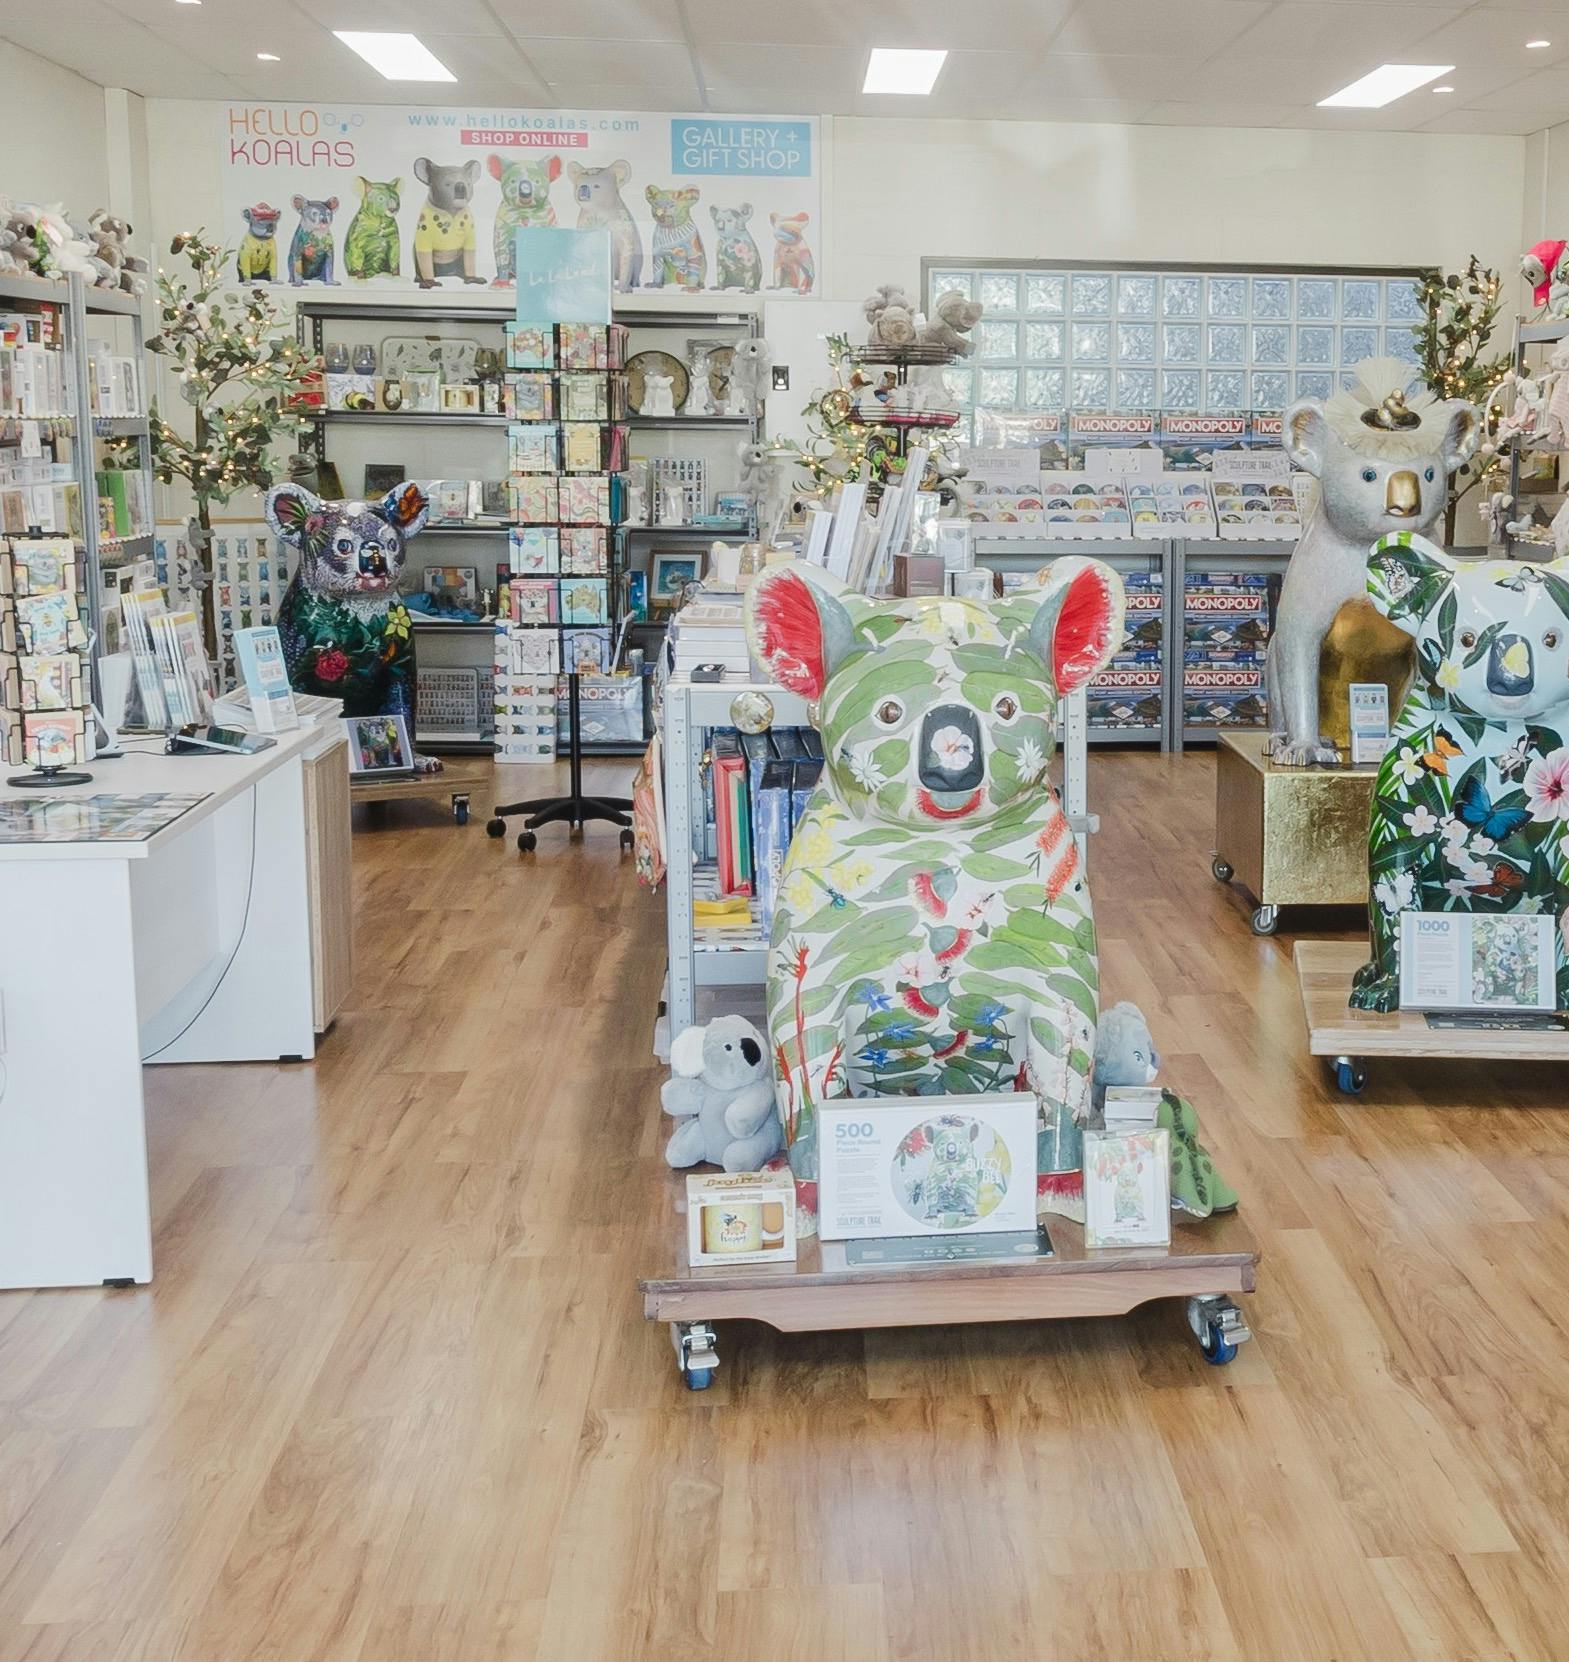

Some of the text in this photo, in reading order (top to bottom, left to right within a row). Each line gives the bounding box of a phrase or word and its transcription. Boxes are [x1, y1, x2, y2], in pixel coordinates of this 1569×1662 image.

[229, 108, 319, 137] HELLO
[408, 112, 640, 132] www.hellokoalas.com
[471, 131, 579, 146] SHOP ONLINE
[682, 126, 780, 148] GALLERY
[230, 138, 356, 168] KOALAS
[682, 148, 801, 170] GIFT SHOP
[1078, 419, 1151, 432] MONOPOLY
[1169, 420, 1243, 433] MONOPOLY
[1185, 597, 1259, 610] MONOPOLY
[1088, 673, 1160, 686] MONOPOLY
[1184, 673, 1258, 686] MONOPOLY
[1416, 919, 1450, 932] 1000
[835, 1122, 874, 1138] 500
